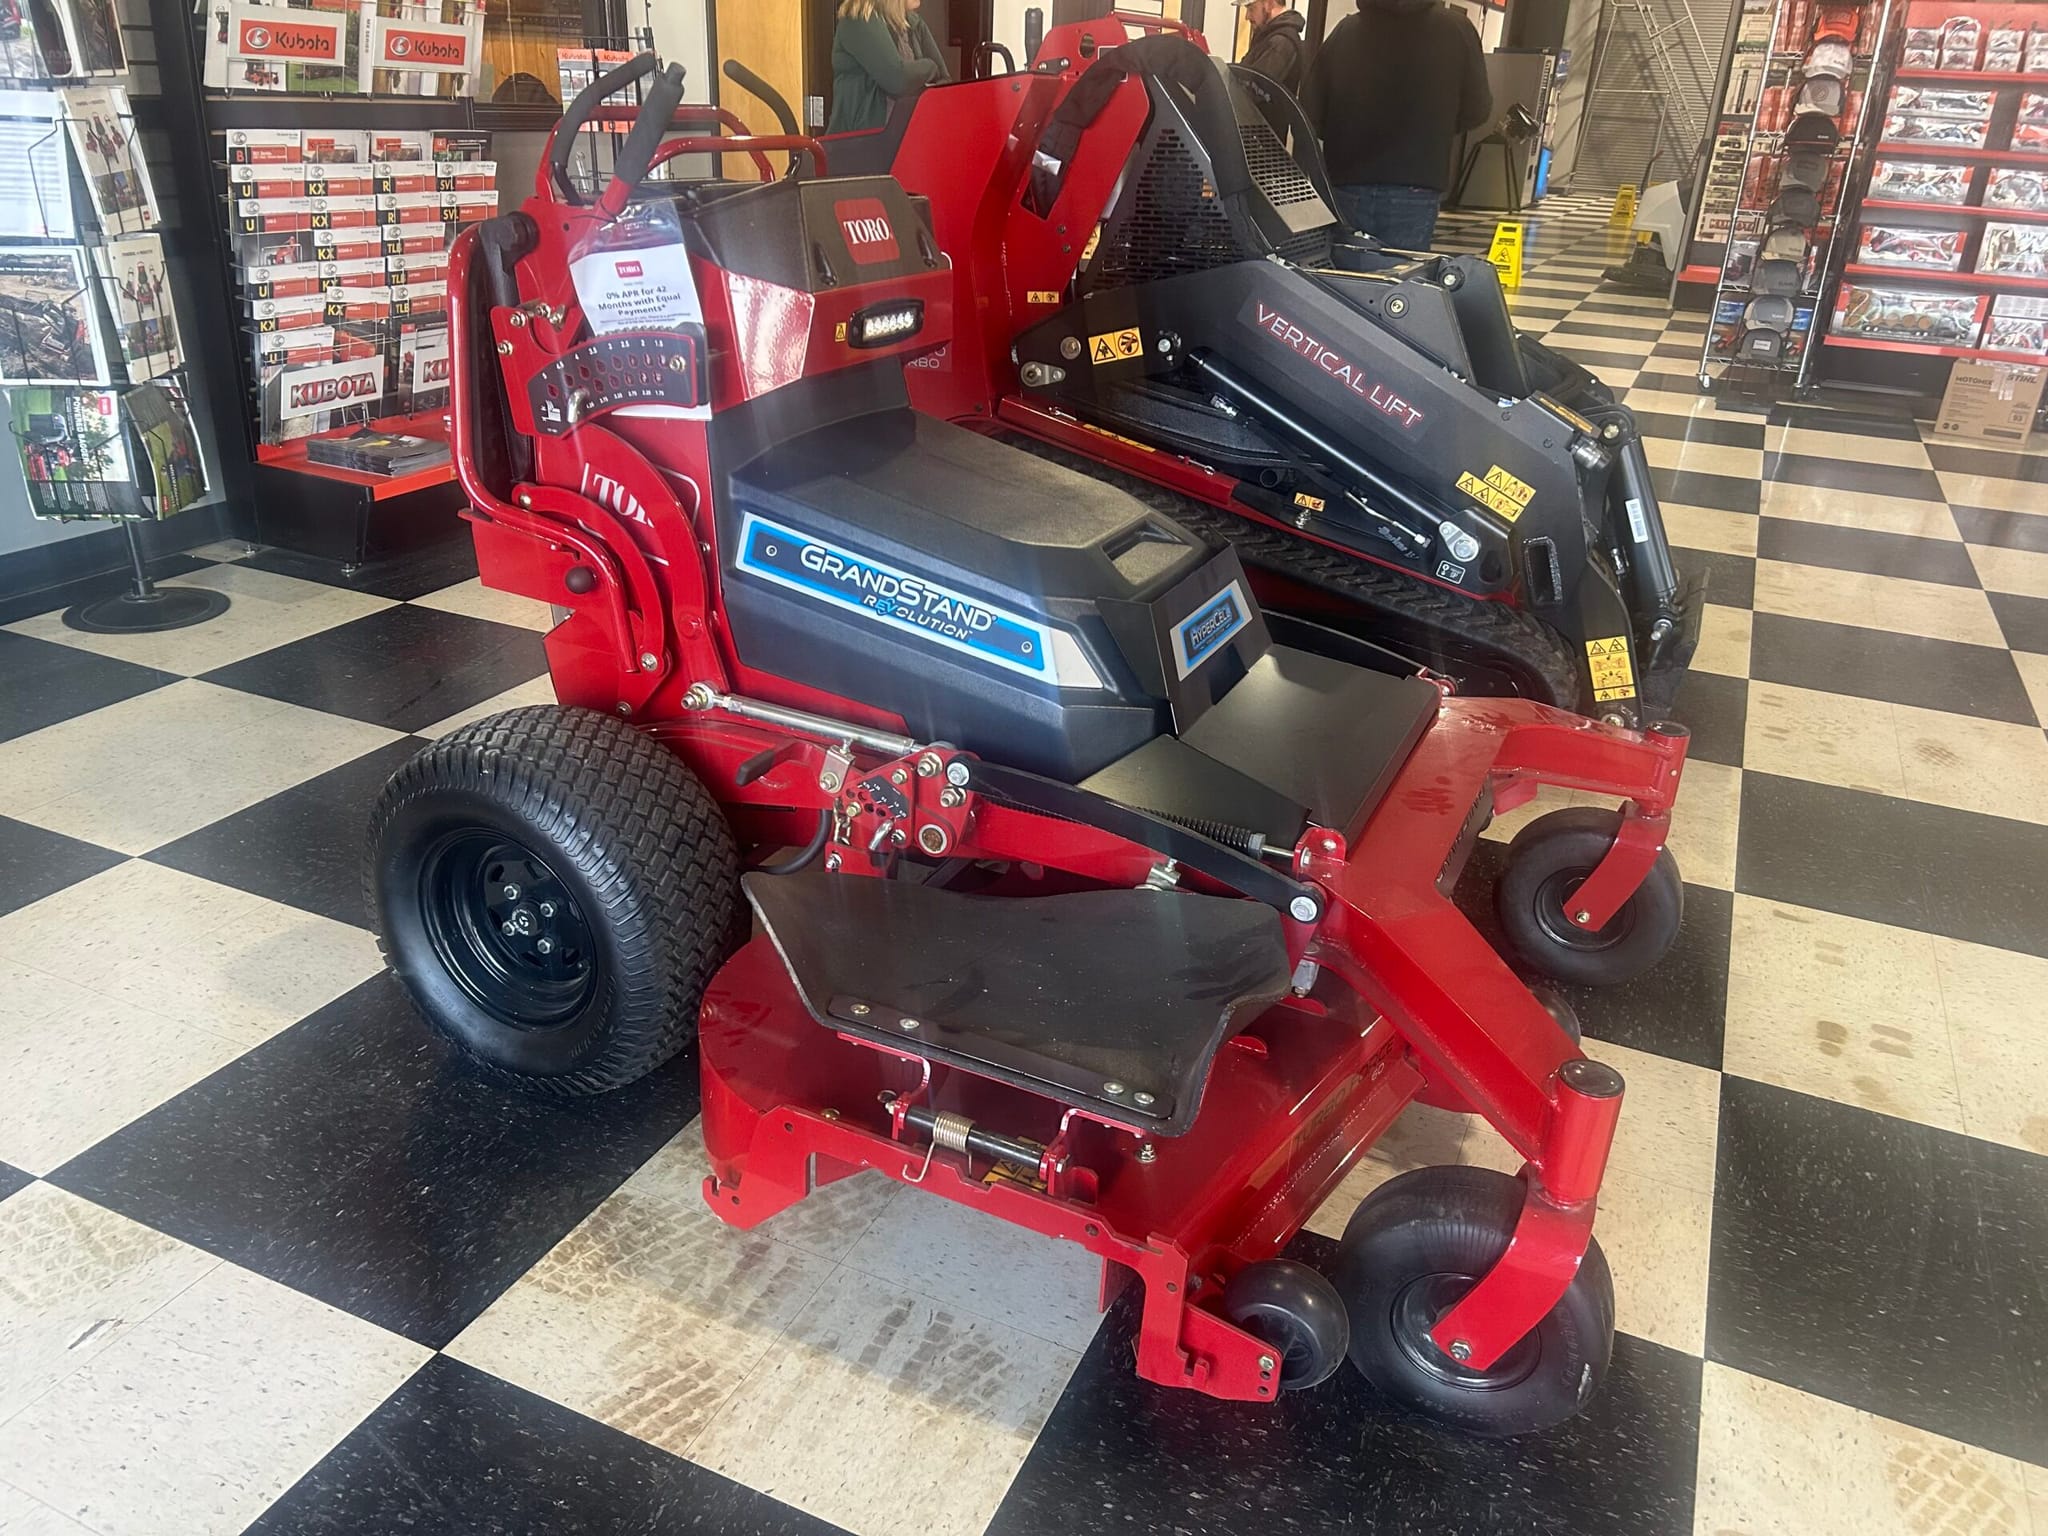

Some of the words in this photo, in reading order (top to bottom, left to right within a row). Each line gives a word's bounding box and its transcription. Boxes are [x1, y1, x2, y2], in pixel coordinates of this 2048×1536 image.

[275, 30, 330, 52] Kubota
[414, 40, 460, 59] Kubota
[236, 150, 244, 162] B
[242, 184, 252, 197] U
[309, 183, 326, 195] KX
[246, 219, 254, 231] U
[312, 217, 328, 228] KX
[843, 216, 890, 244] TORO
[318, 248, 334, 260] KX
[258, 286, 267, 298] U
[606, 292, 620, 300] 0%
[622, 290, 640, 298] APR
[641, 288, 654, 296] for
[598, 301, 632, 311] Months
[634, 297, 654, 306] with
[656, 292, 681, 302] Equal
[328, 304, 344, 316] KX
[396, 304, 410, 313] TLB
[260, 320, 275, 332] KX
[620, 340, 630, 348] 2.5
[654, 339, 664, 347] 1.5
[1257, 302, 1364, 392] VERTICAL
[1369, 384, 1422, 426] LIFT
[2006, 374, 2038, 384] STIHL
[290, 372, 376, 409] KUBOTA
[800, 545, 992, 633] GRANDSTAND
[863, 594, 968, 640] REVOLUTION
[1191, 608, 1233, 646] HYPERCELL
